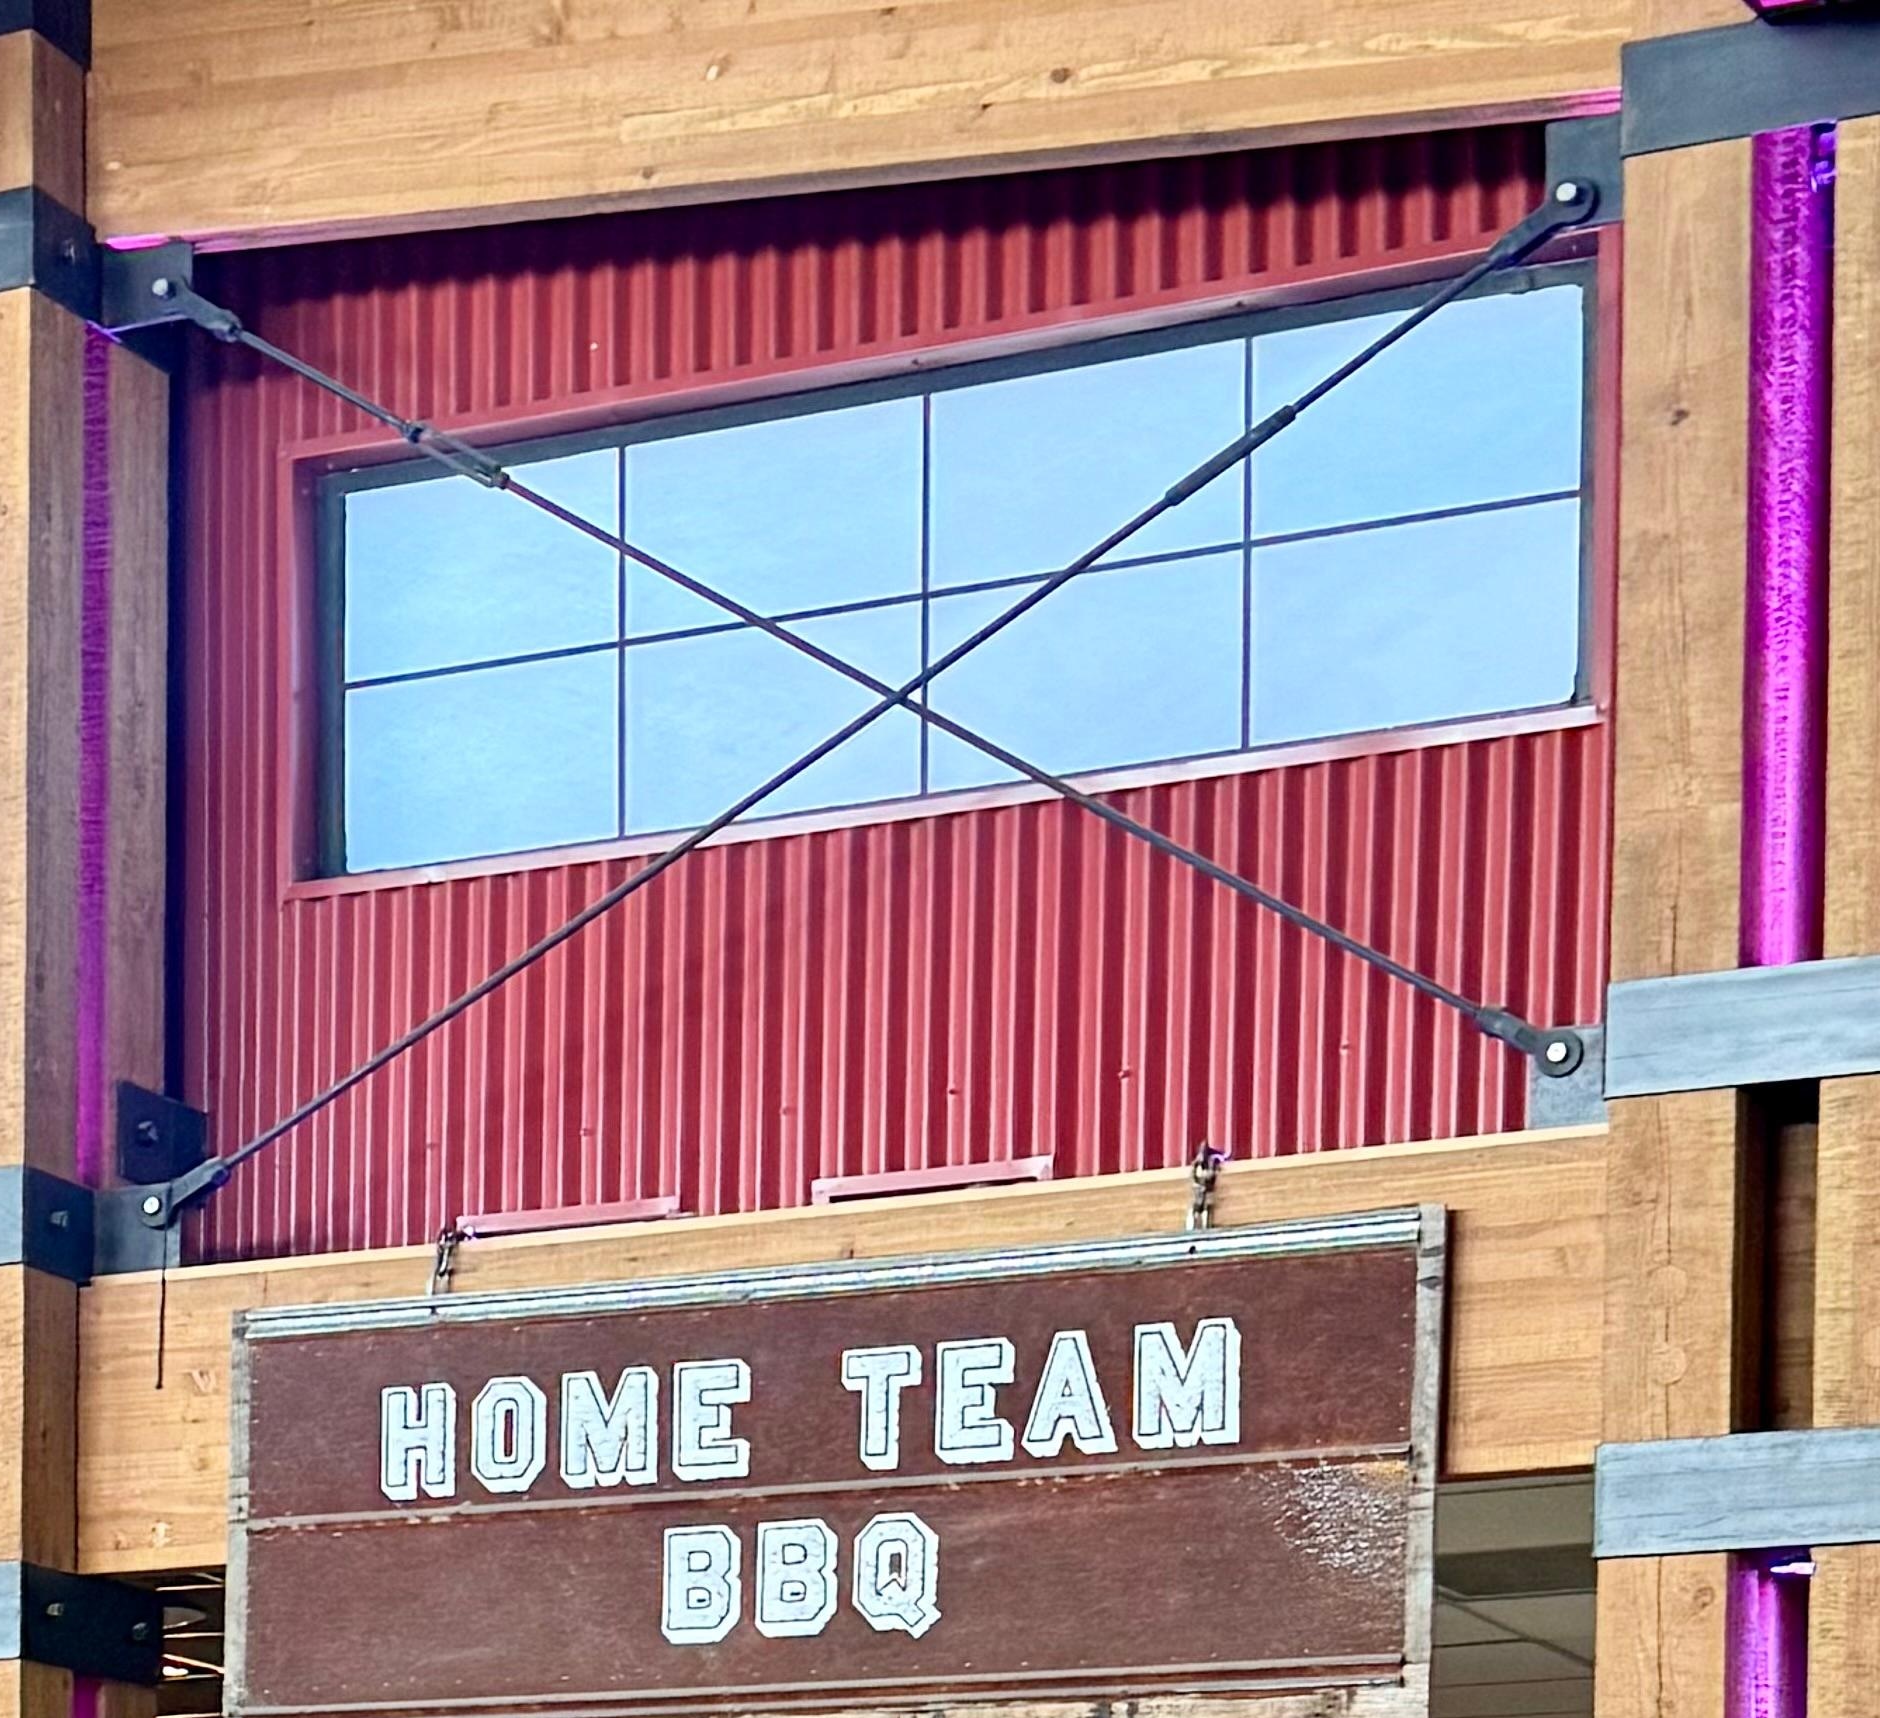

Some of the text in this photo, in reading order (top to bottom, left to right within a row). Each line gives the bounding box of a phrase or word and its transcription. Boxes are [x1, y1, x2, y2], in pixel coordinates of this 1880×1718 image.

[380, 1316, 1241, 1502] HOME TEAM
[661, 1512, 940, 1644] BBQ
